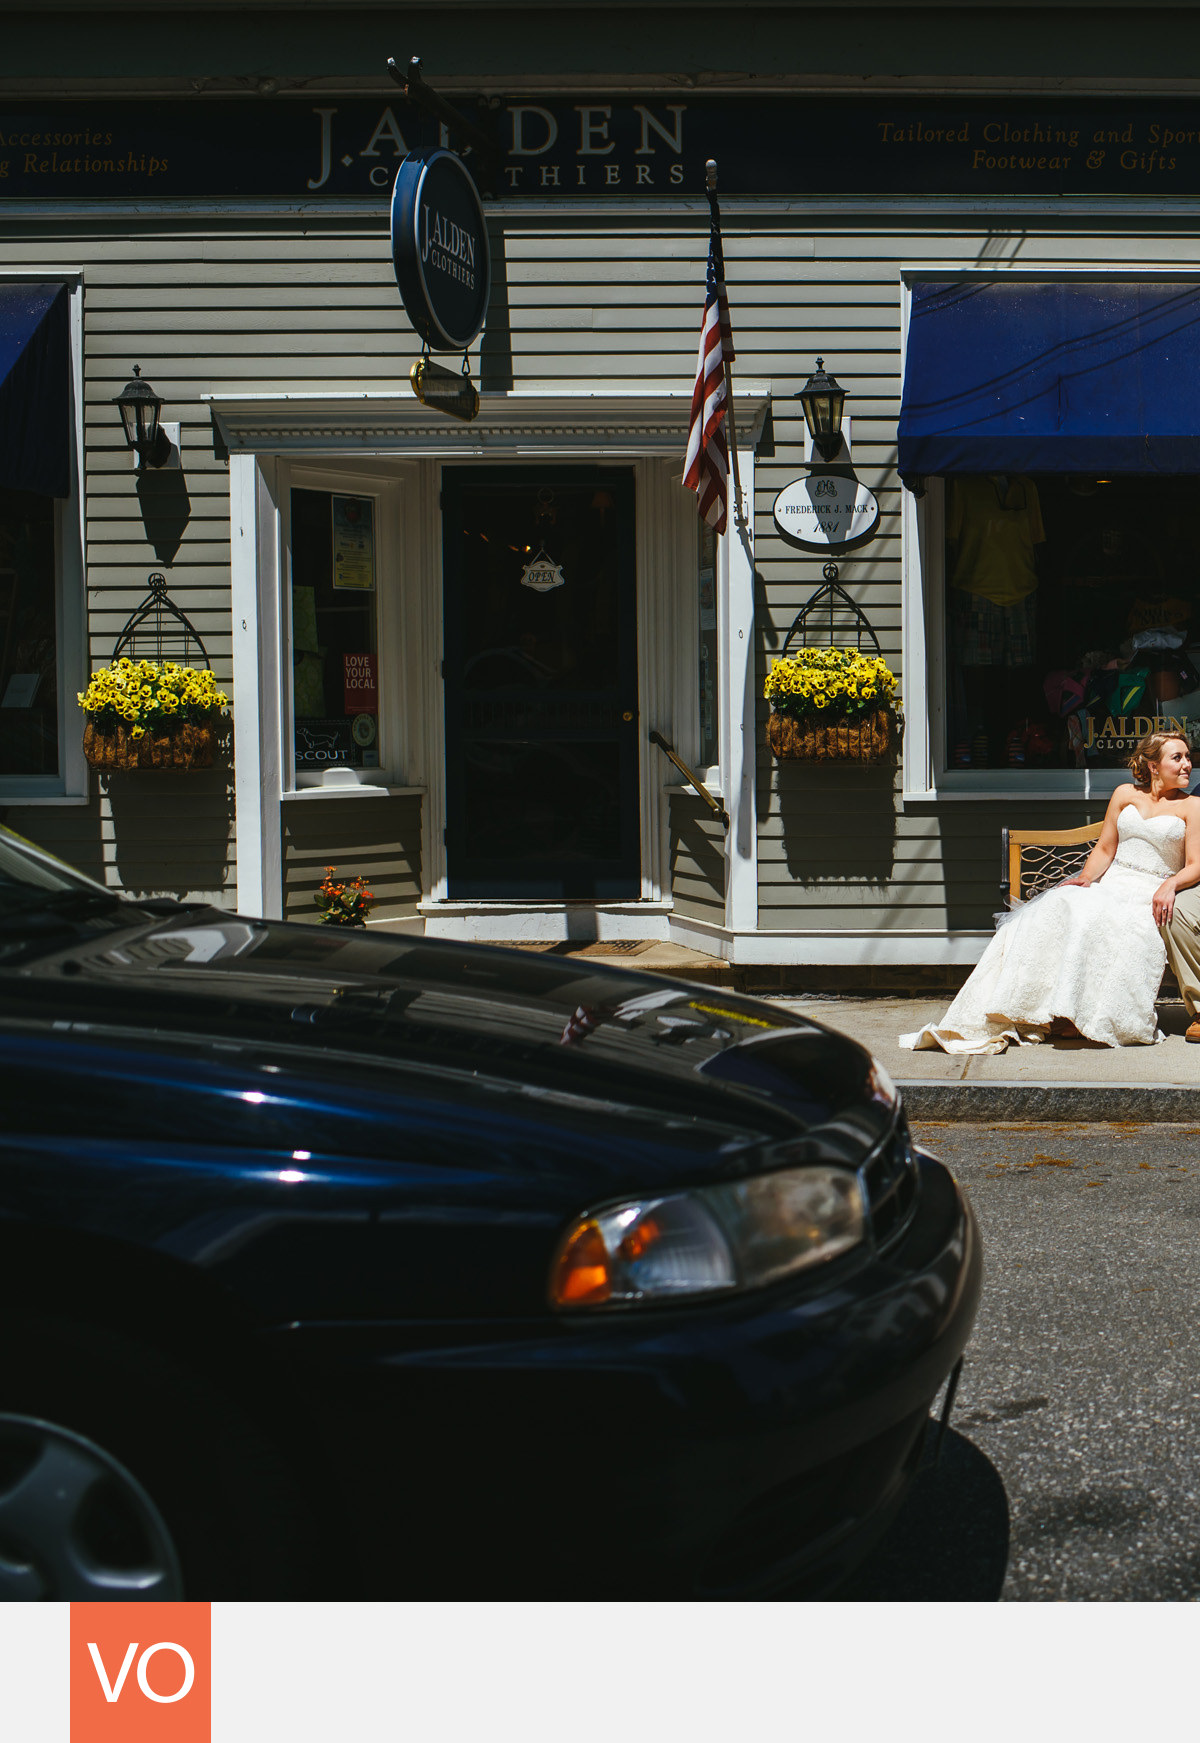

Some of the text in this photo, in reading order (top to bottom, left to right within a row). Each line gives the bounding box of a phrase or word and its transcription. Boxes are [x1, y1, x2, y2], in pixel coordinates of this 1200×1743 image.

[877, 121, 970, 143] Tailored
[982, 121, 1081, 148] Clothing
[1093, 122, 1135, 144] and
[23, 151, 169, 177] Relationships
[971, 149, 1178, 175] Footwear & Gifts
[369, 164, 685, 188] CTHIERS
[422, 203, 476, 269] J.ALDEN
[431, 248, 476, 291] CLOTHIERS
[785, 503, 869, 514] FREDERICK J. MACK
[813, 520, 840, 533] 1881
[528, 571, 556, 582] OPEN
[345, 656, 369, 667] LOVE
[345, 667, 372, 678] YOUR
[346, 679, 376, 689] LOCAL
[1083, 716, 1188, 749] J.ALDEN
[294, 750, 348, 761] SCOUT
